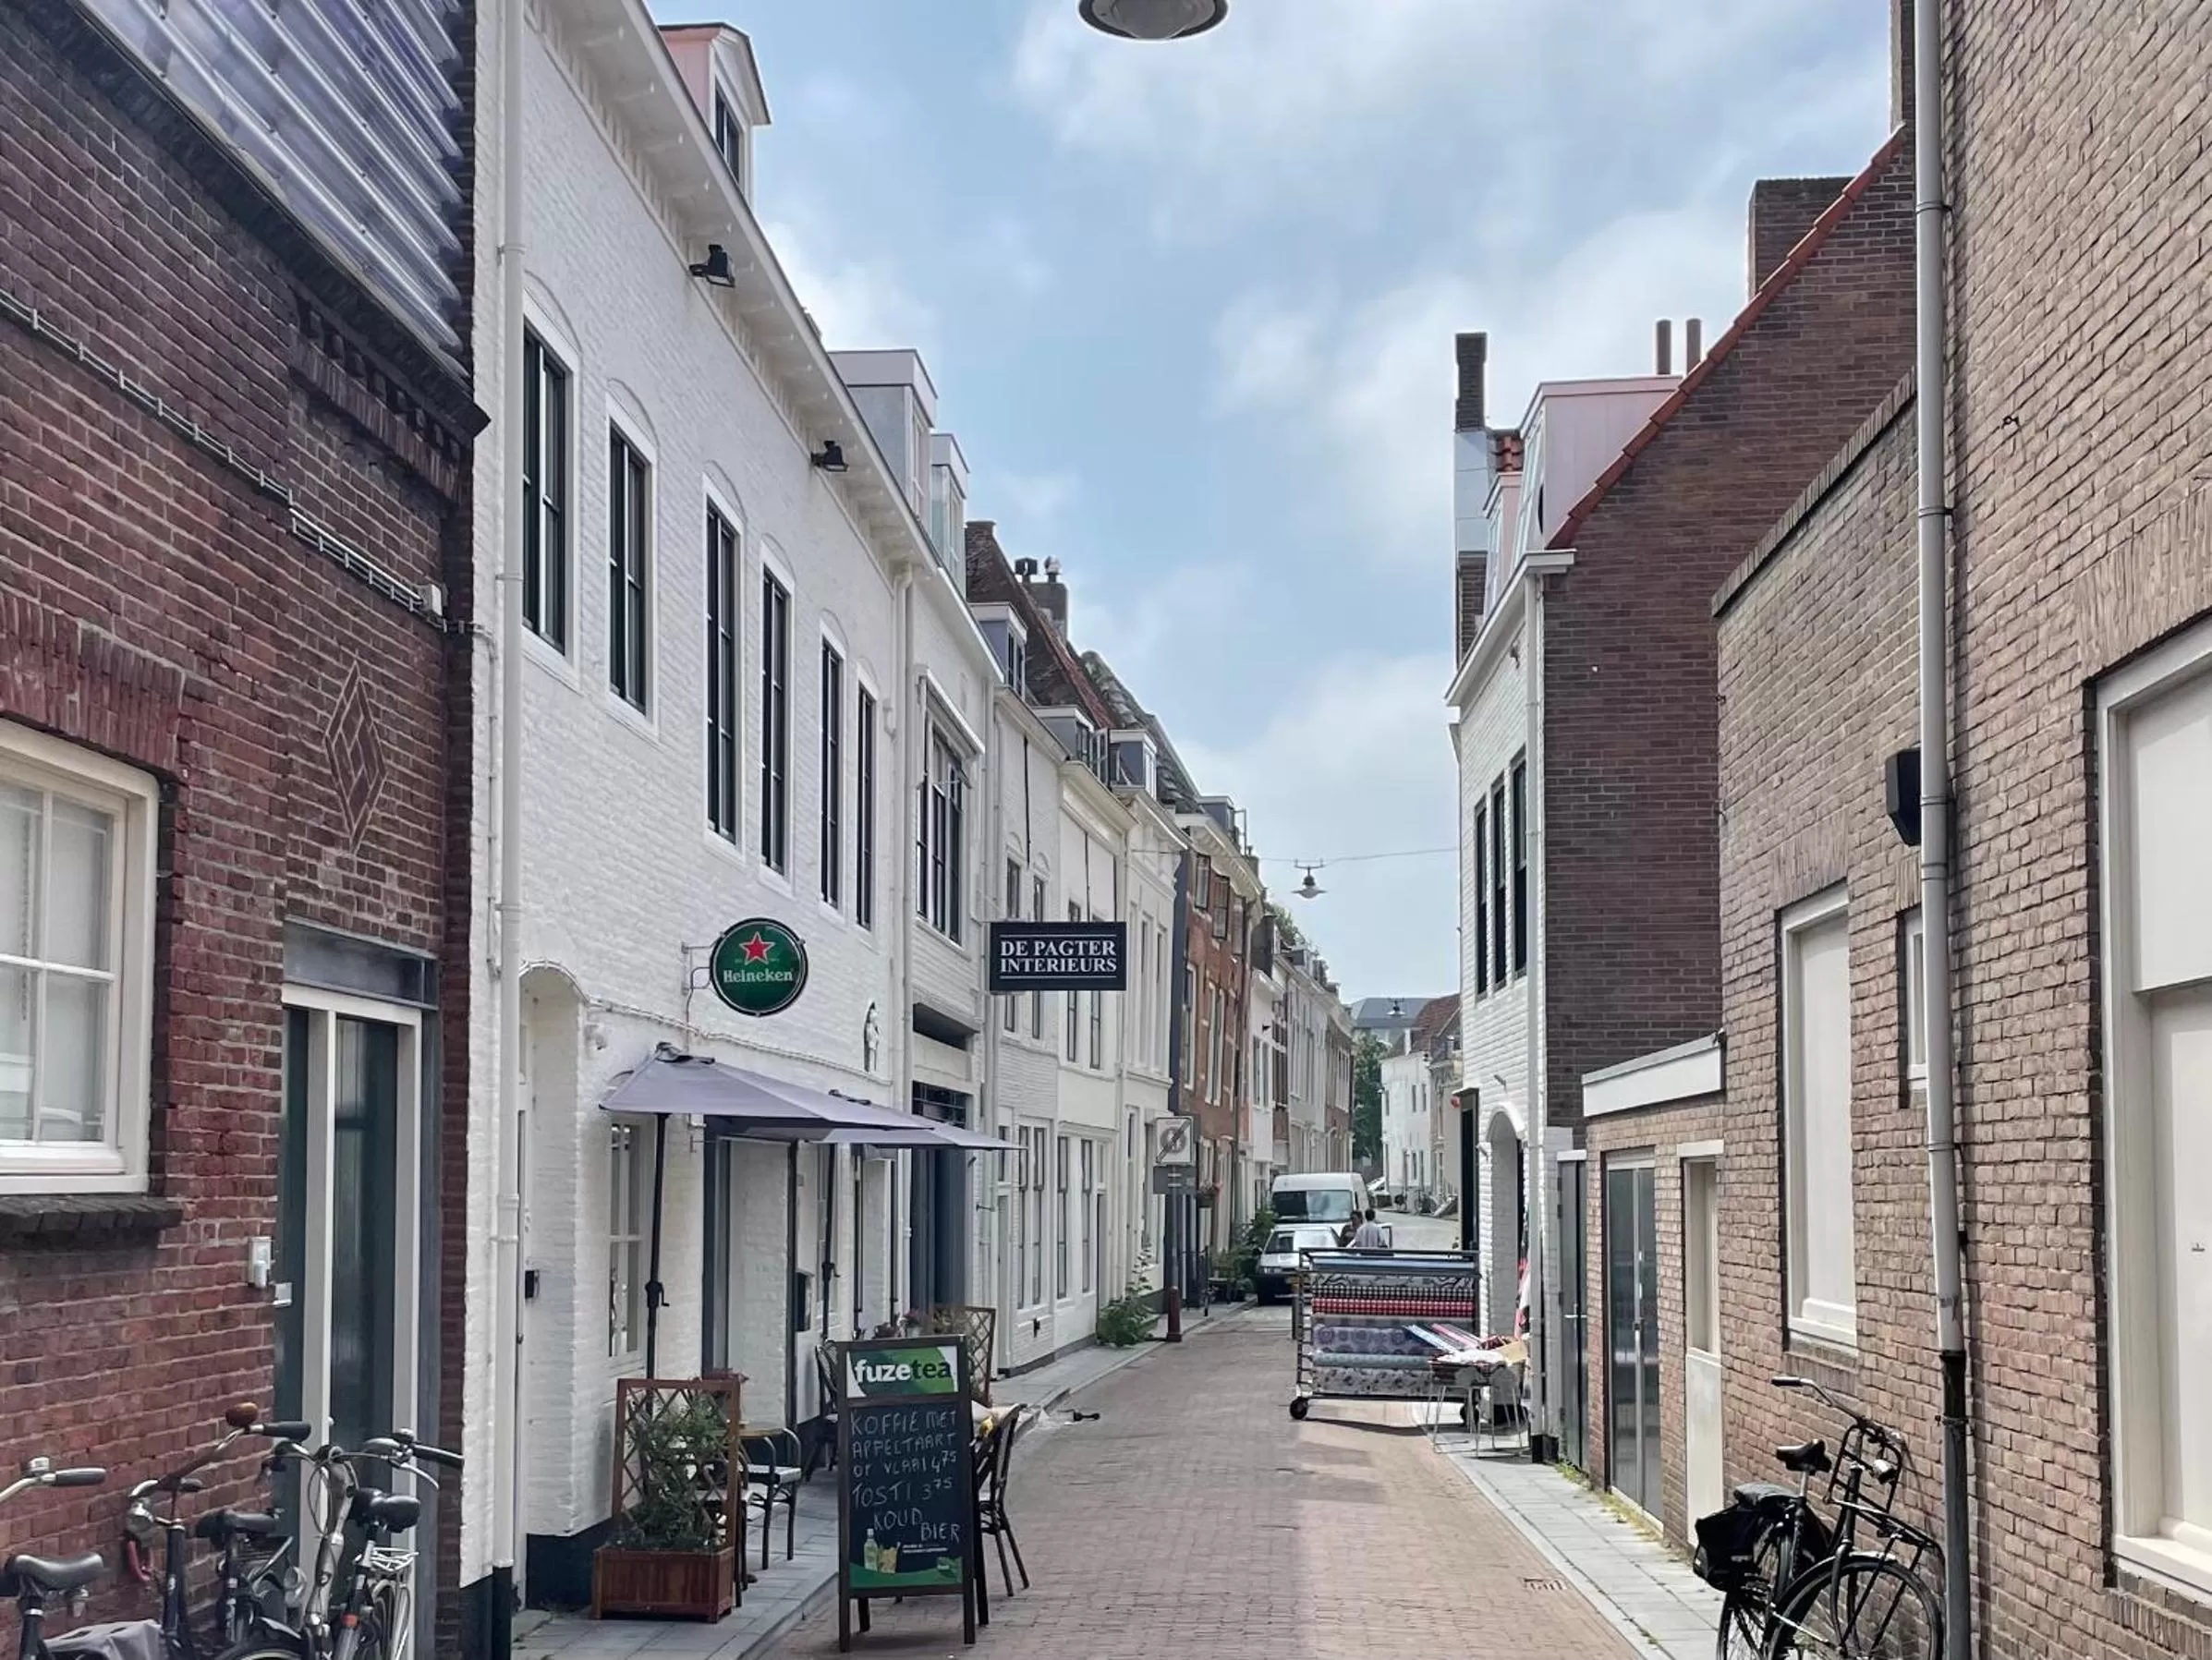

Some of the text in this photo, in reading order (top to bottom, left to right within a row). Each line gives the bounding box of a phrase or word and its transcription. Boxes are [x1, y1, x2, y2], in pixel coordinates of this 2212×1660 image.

[1001, 940, 1116, 956] DE PAGTER
[1001, 958, 1117, 973] INTERIEURS
[723, 969, 793, 983] Heineken
[850, 1410, 957, 1436] KOFFIE MET
[883, 1457, 927, 1475] VLAAI
[852, 1480, 912, 1509] TOSTI
[874, 1508, 923, 1531] KOUD
[920, 1521, 961, 1544] BIER
